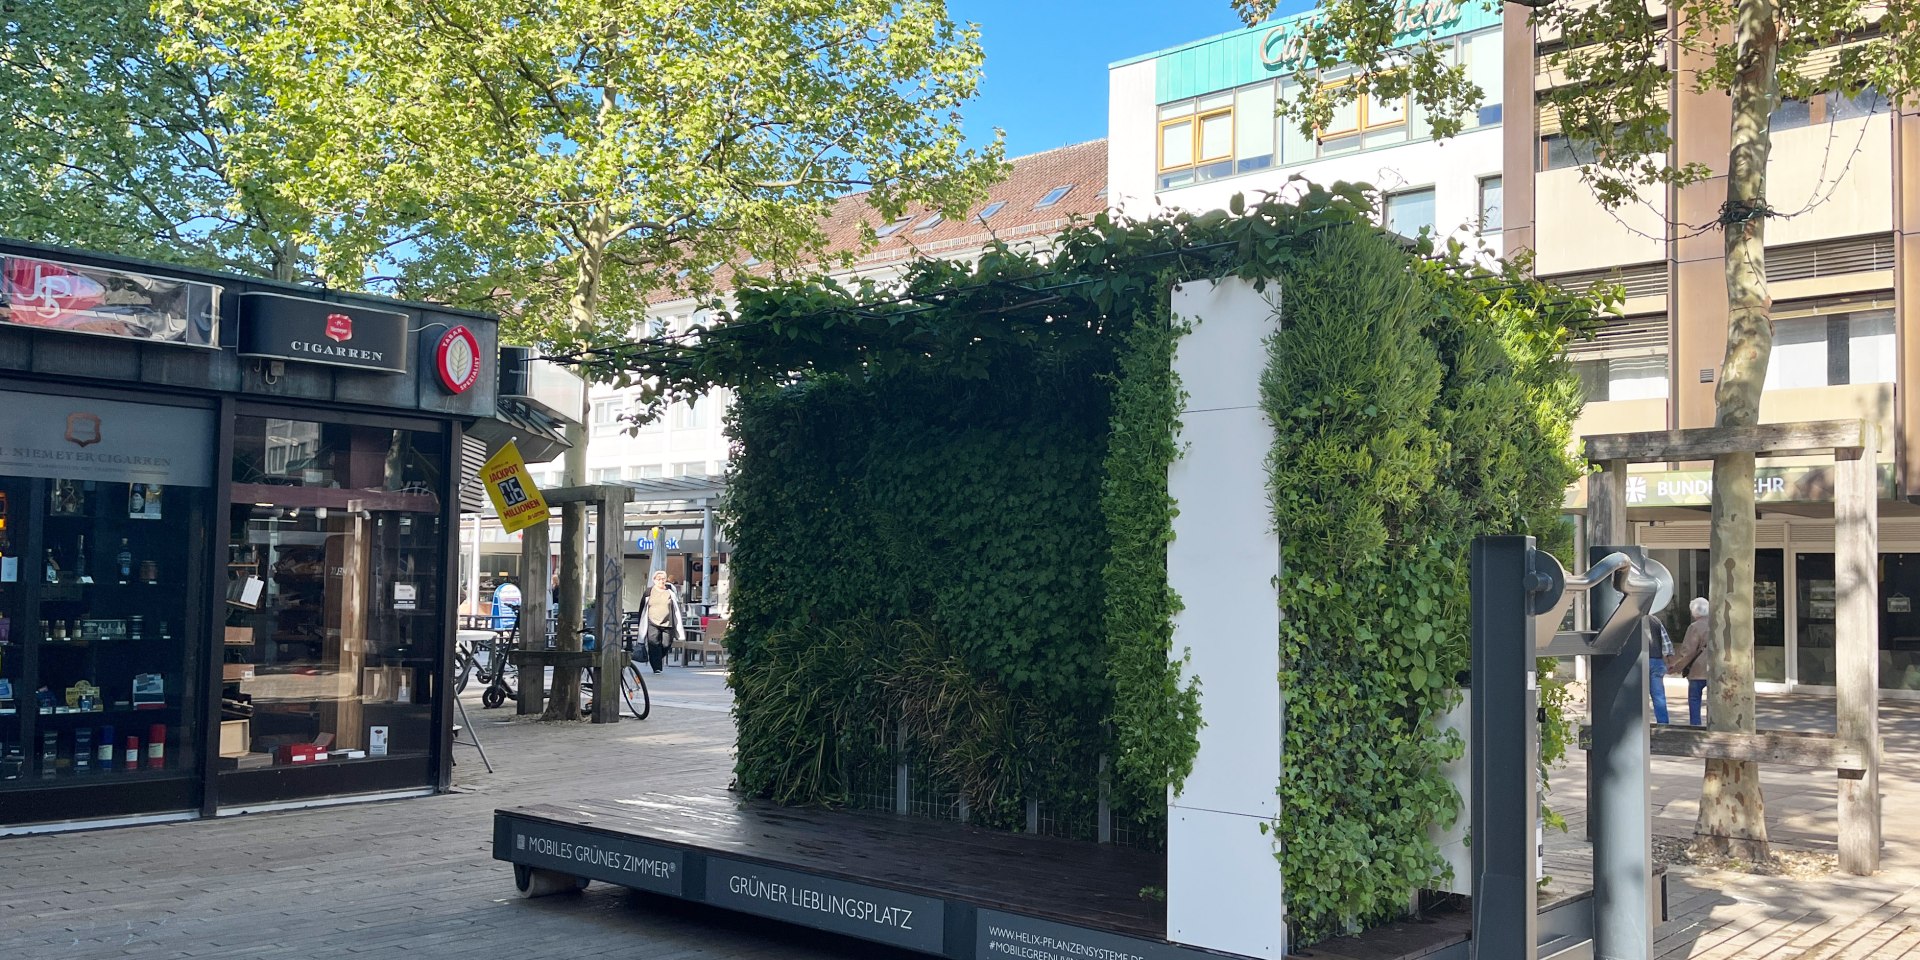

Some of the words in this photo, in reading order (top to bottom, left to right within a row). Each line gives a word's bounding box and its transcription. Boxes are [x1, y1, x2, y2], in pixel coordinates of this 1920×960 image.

[442, 328, 463, 347] TABAK
[290, 341, 383, 361] CIGARREN
[459, 357, 480, 391] SPEZIALIST
[12, 447, 95, 463] NIEMEYER
[97, 452, 171, 467] CIGARREN
[489, 464, 519, 484] JACKPOT
[1657, 477, 1785, 496] BUNDHR
[503, 499, 540, 519] MILLIONEN
[529, 836, 572, 859] MOBILES
[574, 844, 620, 869] GRÜNES
[729, 875, 788, 904] GRÜNER
[791, 887, 913, 930] LIEBLINGSPLATZ
